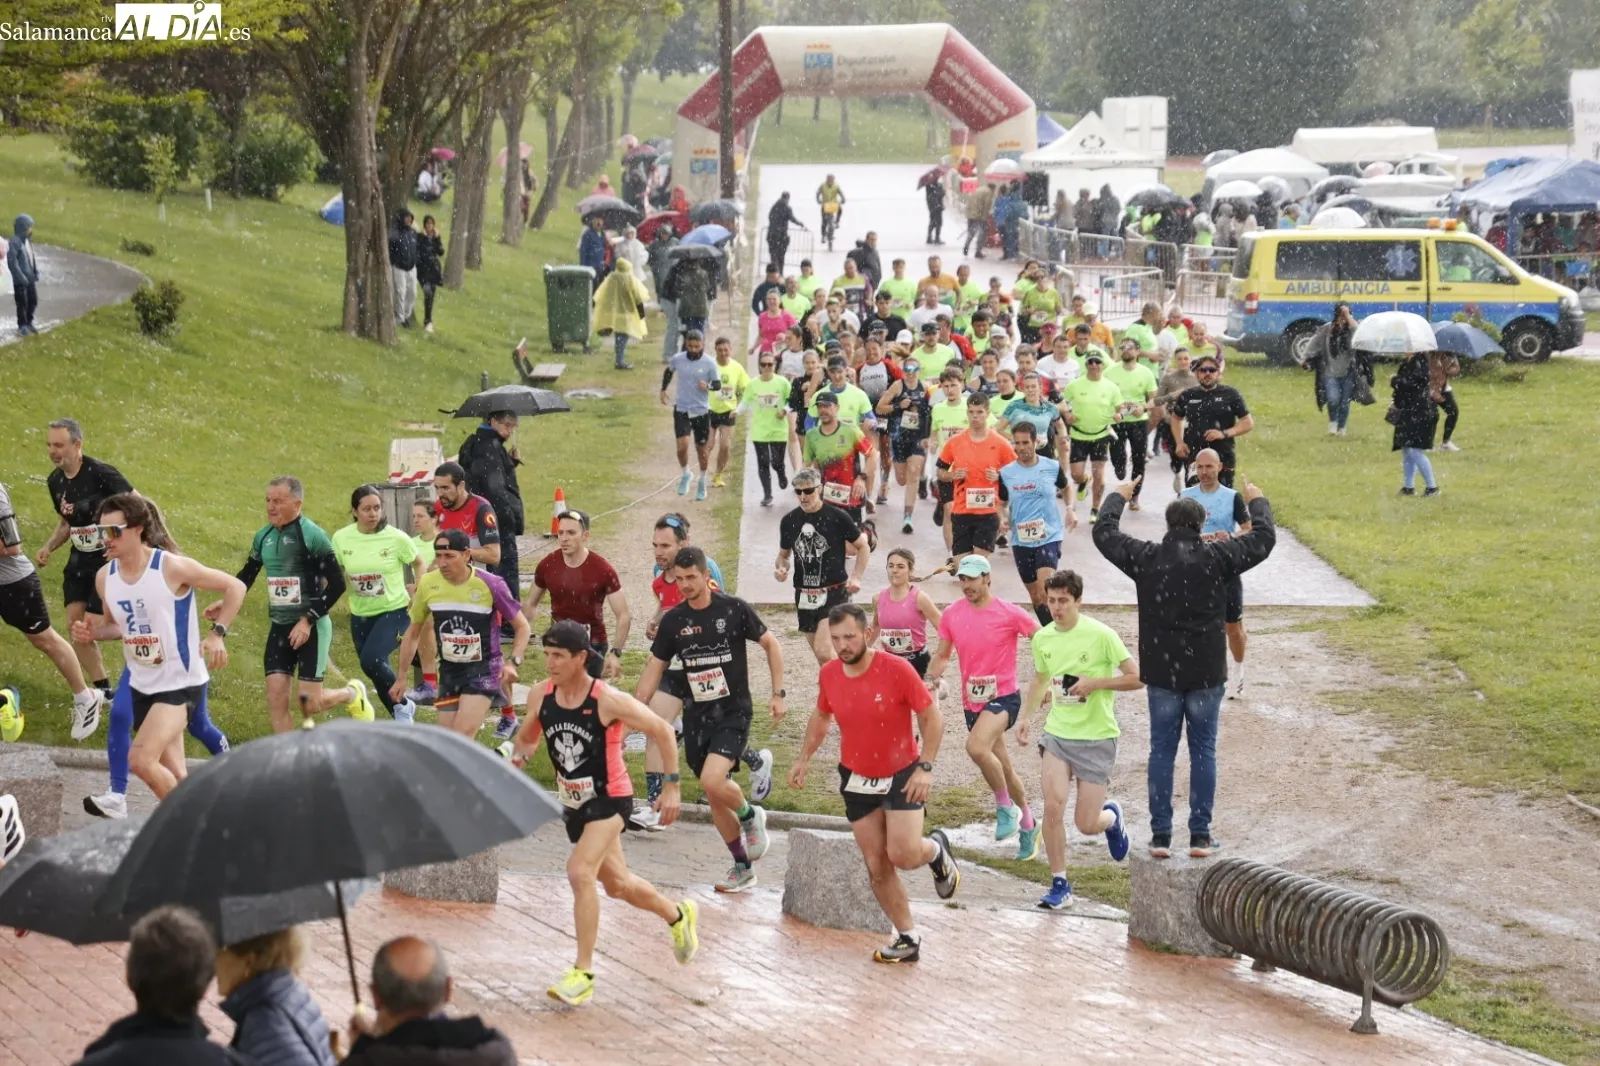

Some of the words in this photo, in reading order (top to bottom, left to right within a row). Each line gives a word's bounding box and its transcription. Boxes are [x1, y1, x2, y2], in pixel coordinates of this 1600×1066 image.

[1285, 281, 1392, 296] AMBULANCIA
[830, 489, 842, 499] 66
[974, 494, 987, 503] 63
[1025, 527, 1038, 537] 72
[78, 533, 92, 545] 94
[274, 585, 289, 598] 45
[358, 581, 374, 592] 26
[807, 594, 818, 604] 82
[889, 637, 902, 647] 81
[135, 644, 150, 658] 40
[453, 643, 469, 655] 27
[698, 680, 715, 693] 34
[971, 684, 986, 696] 47
[554, 722, 563, 732] LA
[563, 722, 594, 743] ESCAPADA
